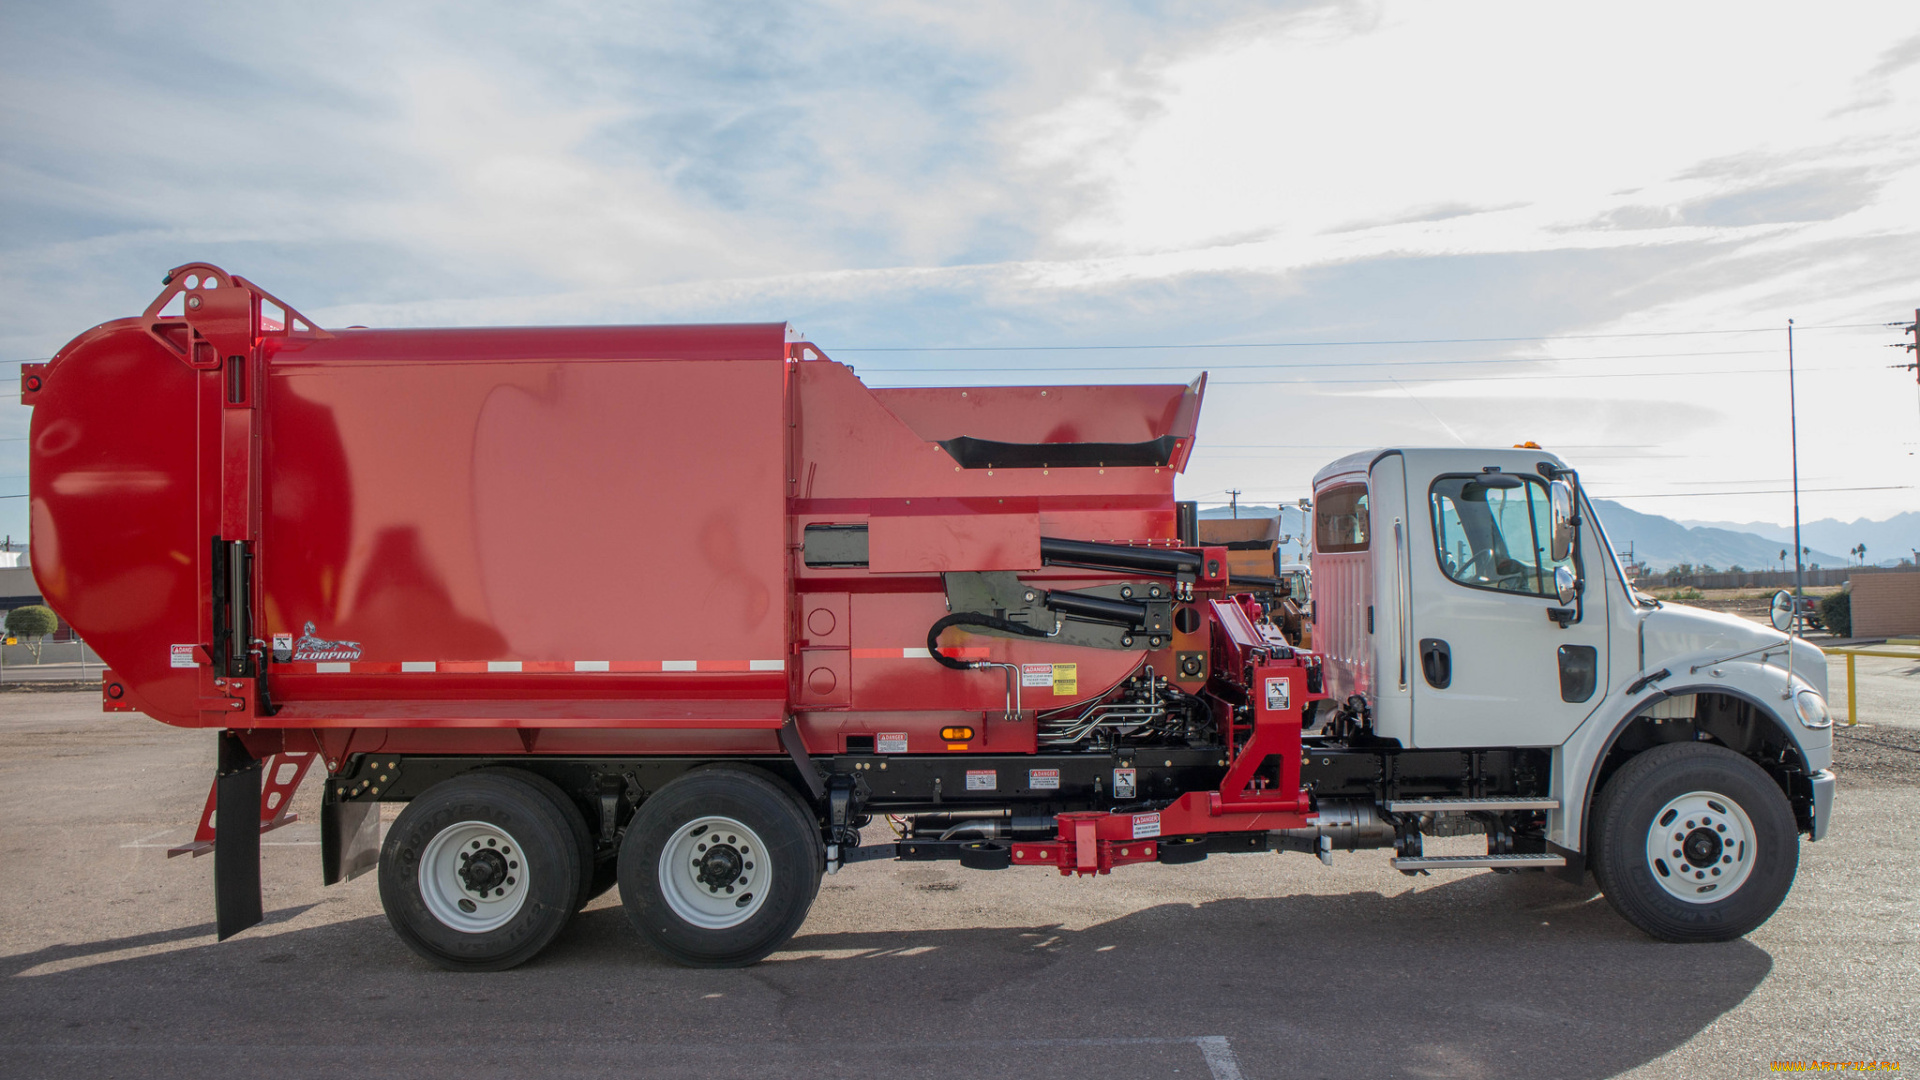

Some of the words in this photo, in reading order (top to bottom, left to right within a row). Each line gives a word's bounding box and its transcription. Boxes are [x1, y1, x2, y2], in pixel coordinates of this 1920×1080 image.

[293, 651, 361, 660] SCORPION
[1140, 815, 1157, 824] DANGER
[401, 803, 511, 879] GOODYEAR
